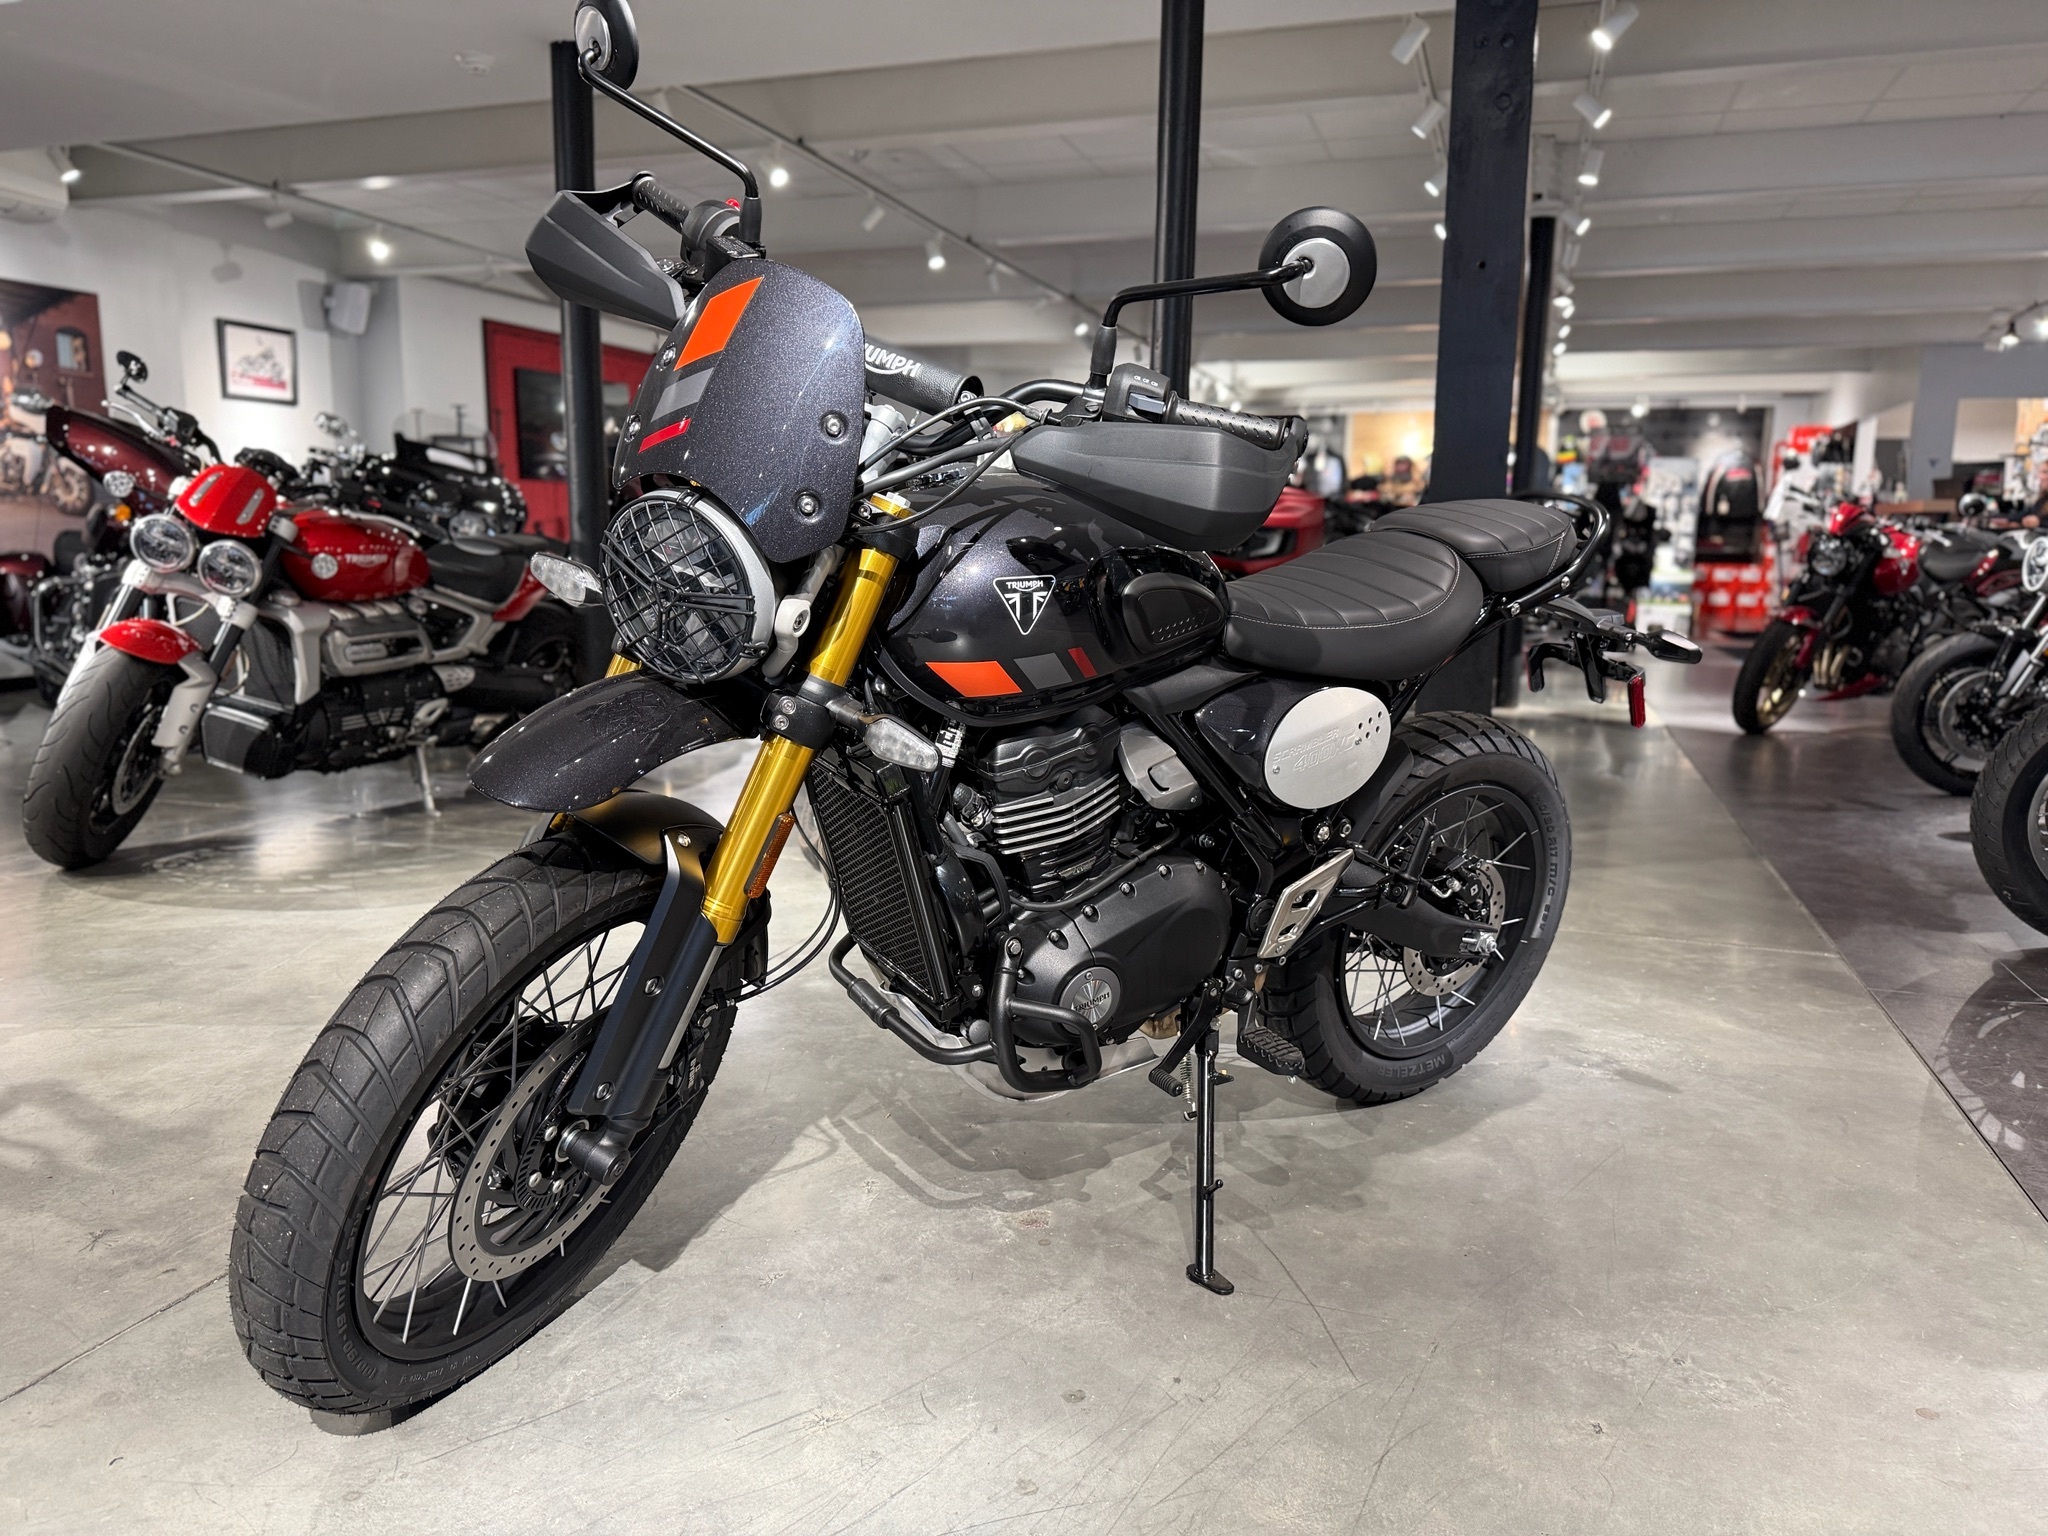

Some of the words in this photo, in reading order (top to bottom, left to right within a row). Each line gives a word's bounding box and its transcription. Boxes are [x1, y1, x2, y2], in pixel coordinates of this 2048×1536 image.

[865, 343, 921, 377] UMPH
[1006, 580, 1044, 590] TRIUMPH
[1273, 727, 1339, 764] SCRAMBLER
[1547, 863, 1559, 896] M/C
[1074, 992, 1110, 1012] TRIUMPH
[1377, 1054, 1446, 1078] METZELER
[336, 1260, 350, 1311] M/C
